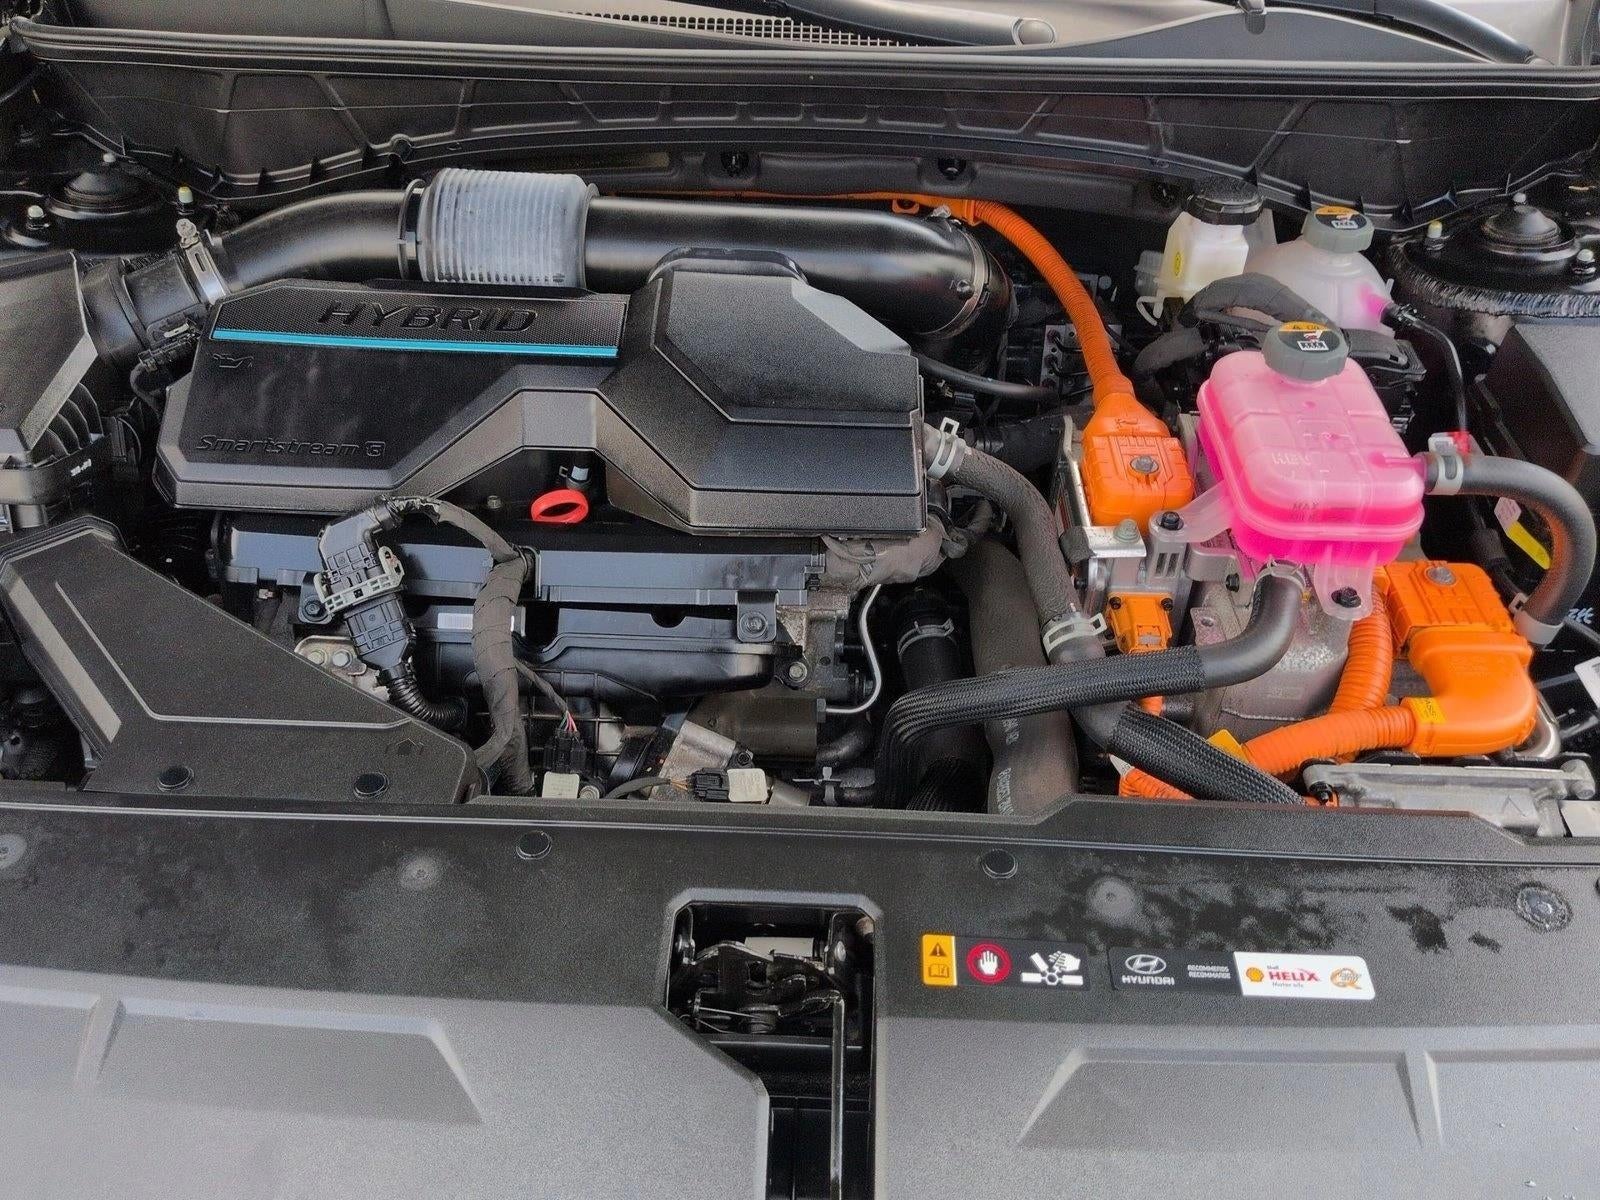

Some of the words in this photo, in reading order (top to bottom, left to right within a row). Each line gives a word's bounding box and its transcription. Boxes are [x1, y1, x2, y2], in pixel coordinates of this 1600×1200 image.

[316, 301, 539, 333] HYBRID
[196, 434, 361, 457] Smartstream
[1121, 974, 1175, 986] HYUNDAI
[1268, 970, 1321, 982] HELIX
